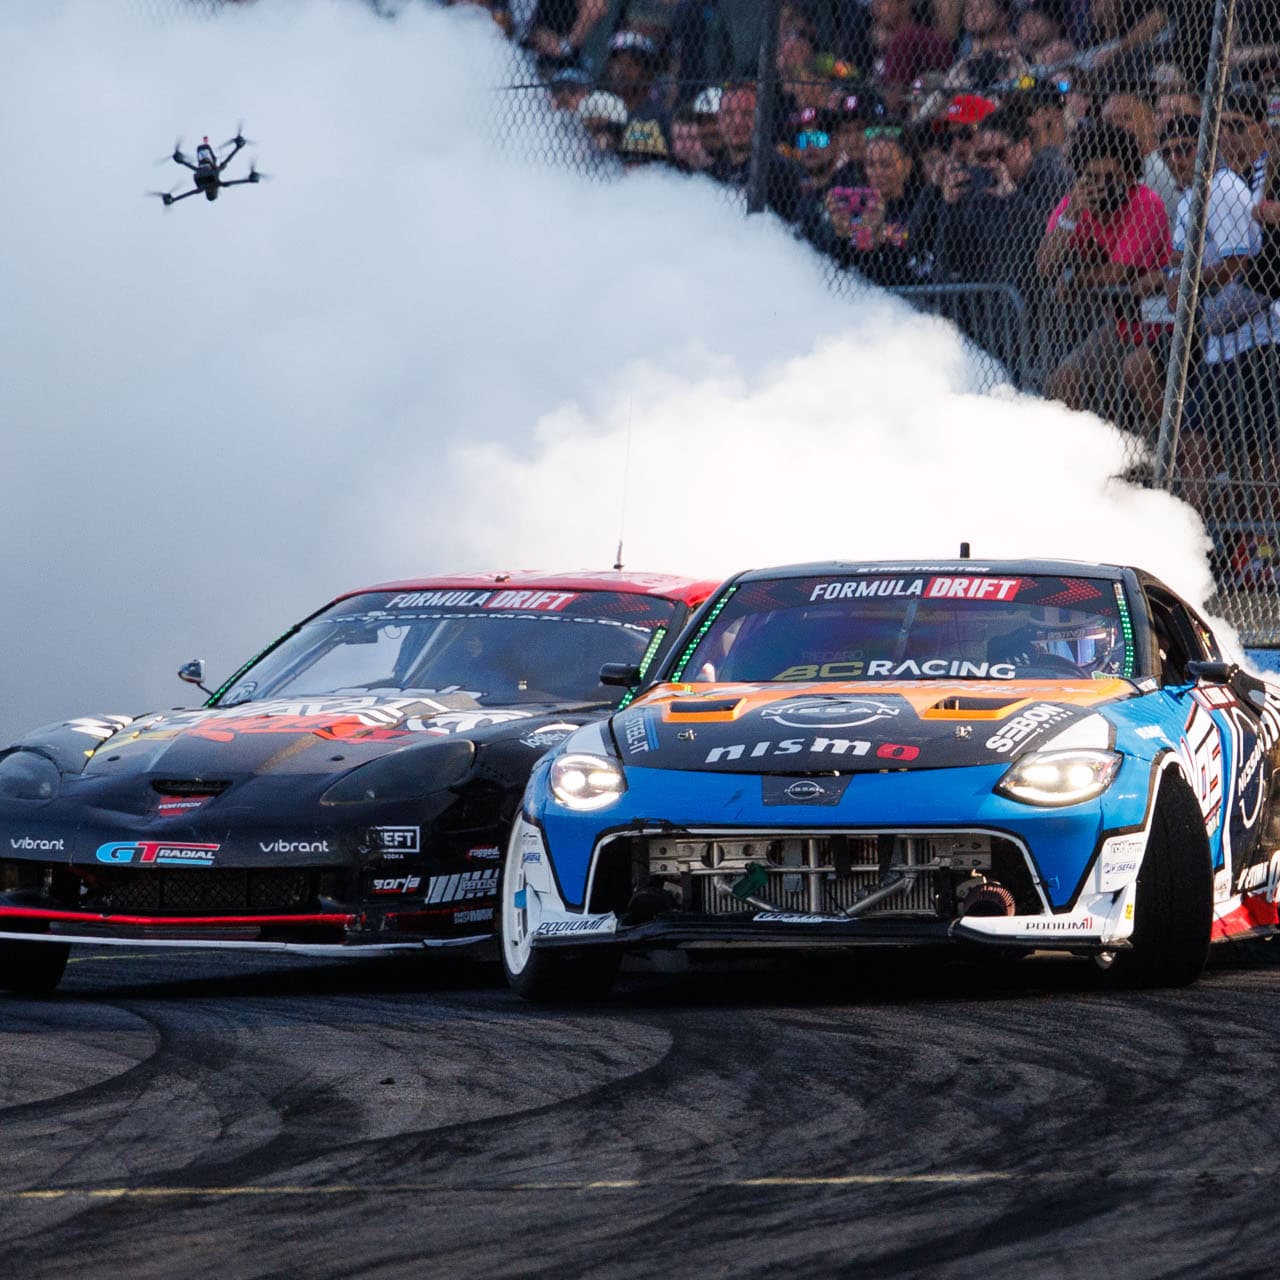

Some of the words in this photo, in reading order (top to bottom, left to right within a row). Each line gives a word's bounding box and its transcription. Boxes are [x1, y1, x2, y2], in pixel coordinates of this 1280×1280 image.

[810, 579, 924, 601] FORMULA
[928, 577, 1018, 600] DRIFT
[385, 591, 489, 609] FORMULA
[495, 590, 574, 611] DRIFT
[773, 661, 864, 680] BC
[867, 660, 1016, 679] RACING
[760, 707, 900, 716] NISSAN
[704, 737, 921, 763] nismo
[158, 801, 202, 810] VORTECH
[10, 837, 65, 850] vibrant
[259, 839, 330, 853] vibrant
[377, 832, 415, 847] EFT
[96, 841, 164, 863] GT
[157, 849, 216, 860] RADIAL
